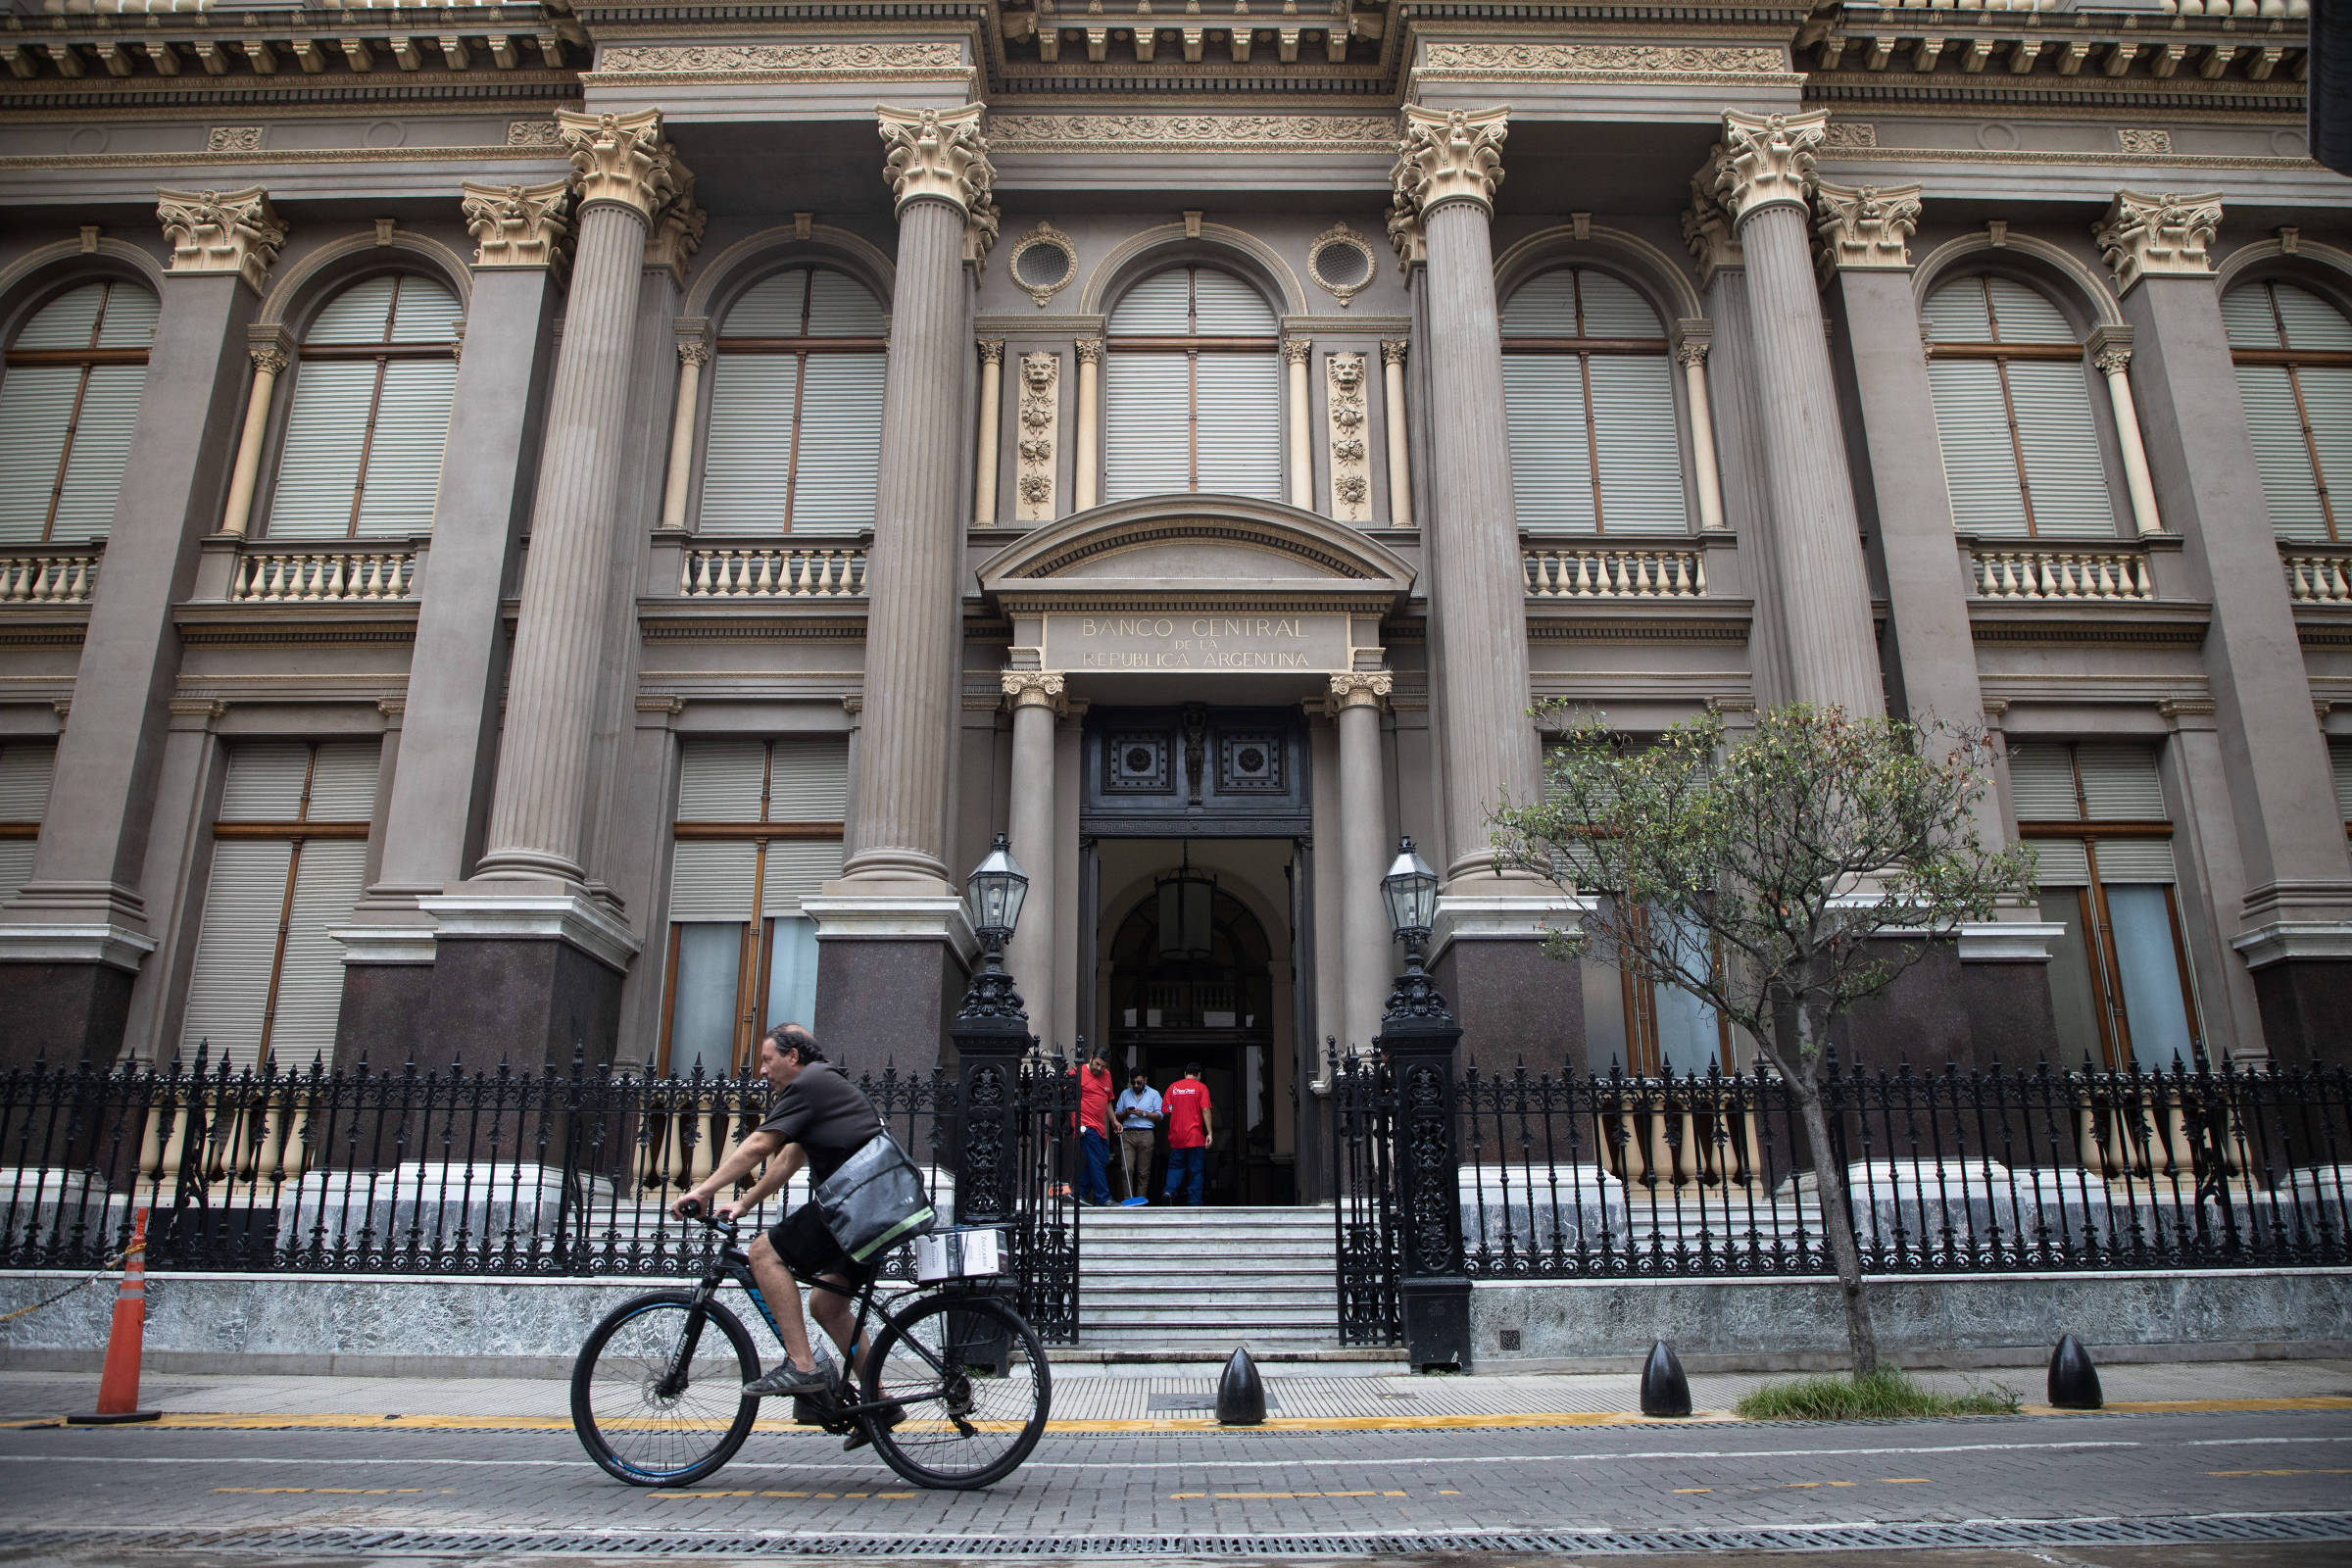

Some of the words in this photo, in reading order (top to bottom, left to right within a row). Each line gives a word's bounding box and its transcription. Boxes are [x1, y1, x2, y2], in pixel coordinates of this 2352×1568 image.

[1083, 618, 1173, 637] BANCO
[1192, 618, 1310, 638] CENTRAL
[1175, 640, 1191, 650] DE
[1200, 640, 1218, 650] LA
[1083, 653, 1190, 666] REPUBLICA
[1203, 653, 1309, 666] ARGENTINA
[669, 1333, 690, 1374] RALEIGH
